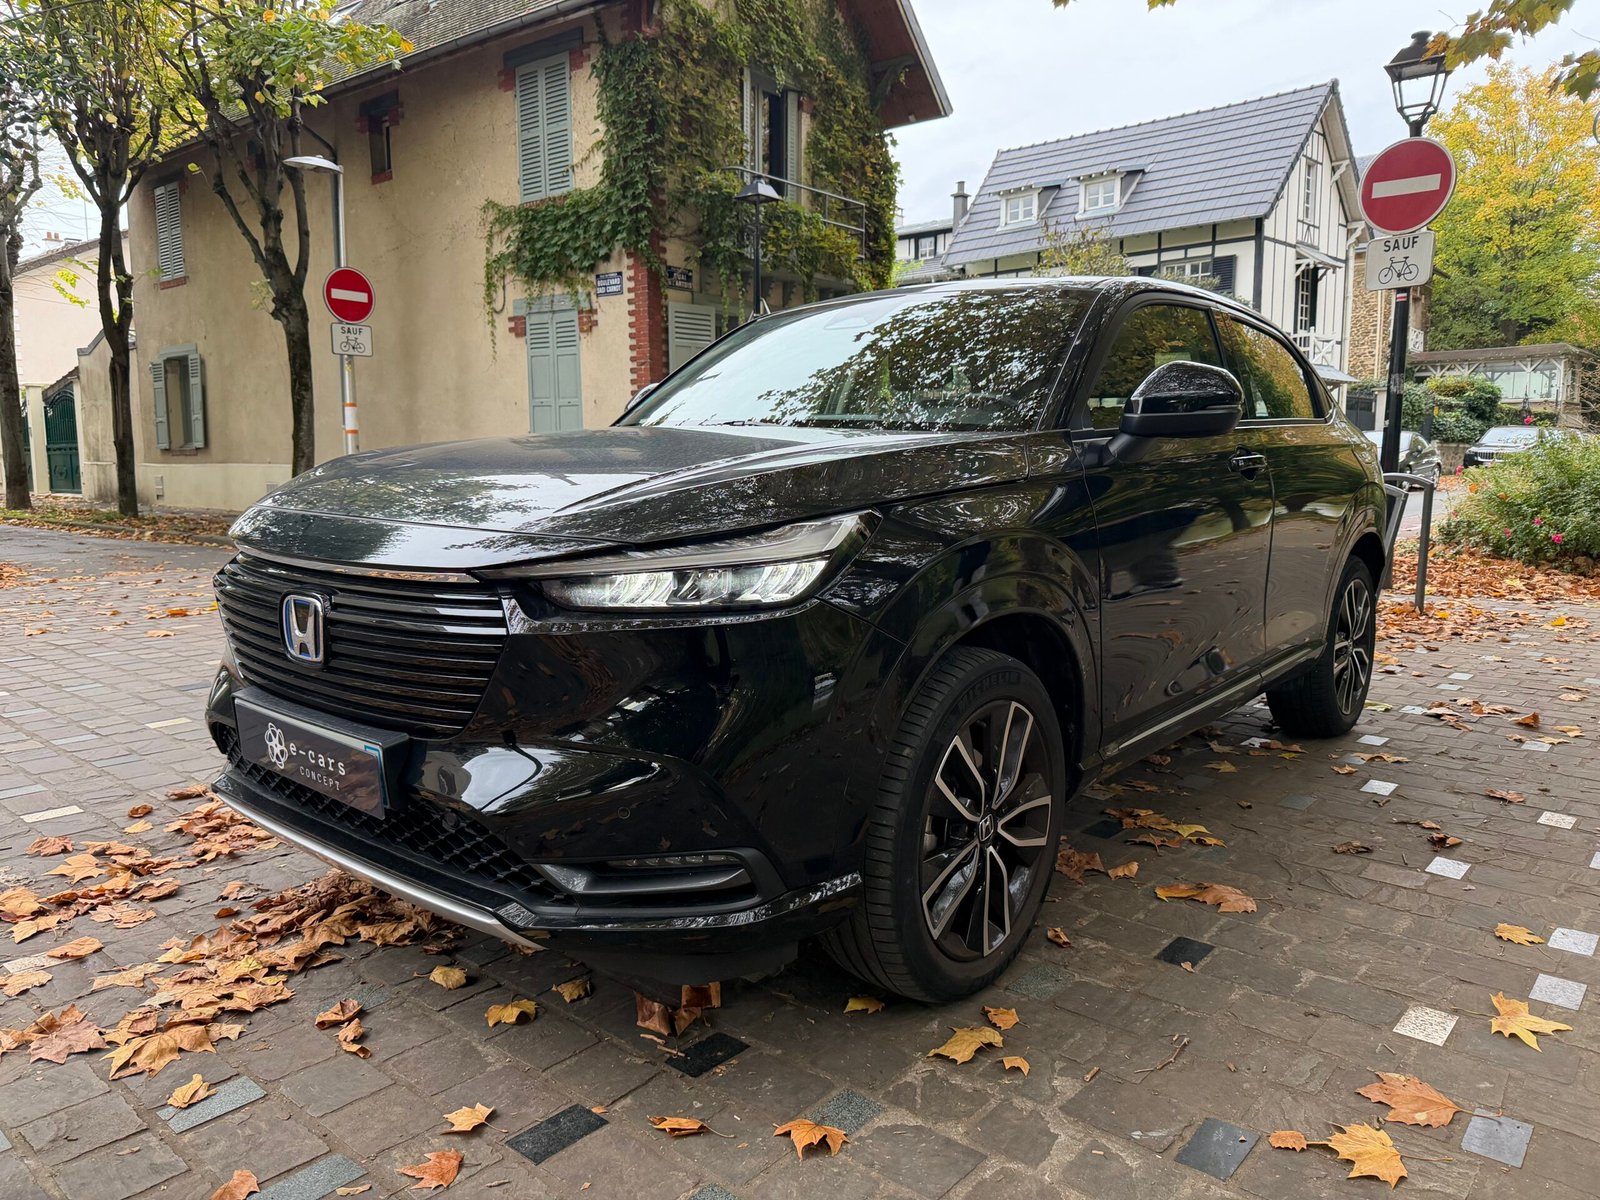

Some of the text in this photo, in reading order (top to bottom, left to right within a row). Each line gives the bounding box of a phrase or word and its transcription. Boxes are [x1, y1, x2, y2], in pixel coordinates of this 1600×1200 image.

[1383, 236, 1419, 252] SAUF
[597, 278, 621, 287] BOULEVARD
[341, 326, 364, 335] SAUF
[289, 742, 346, 776] e-cars
[299, 766, 340, 791] CONCEPT
